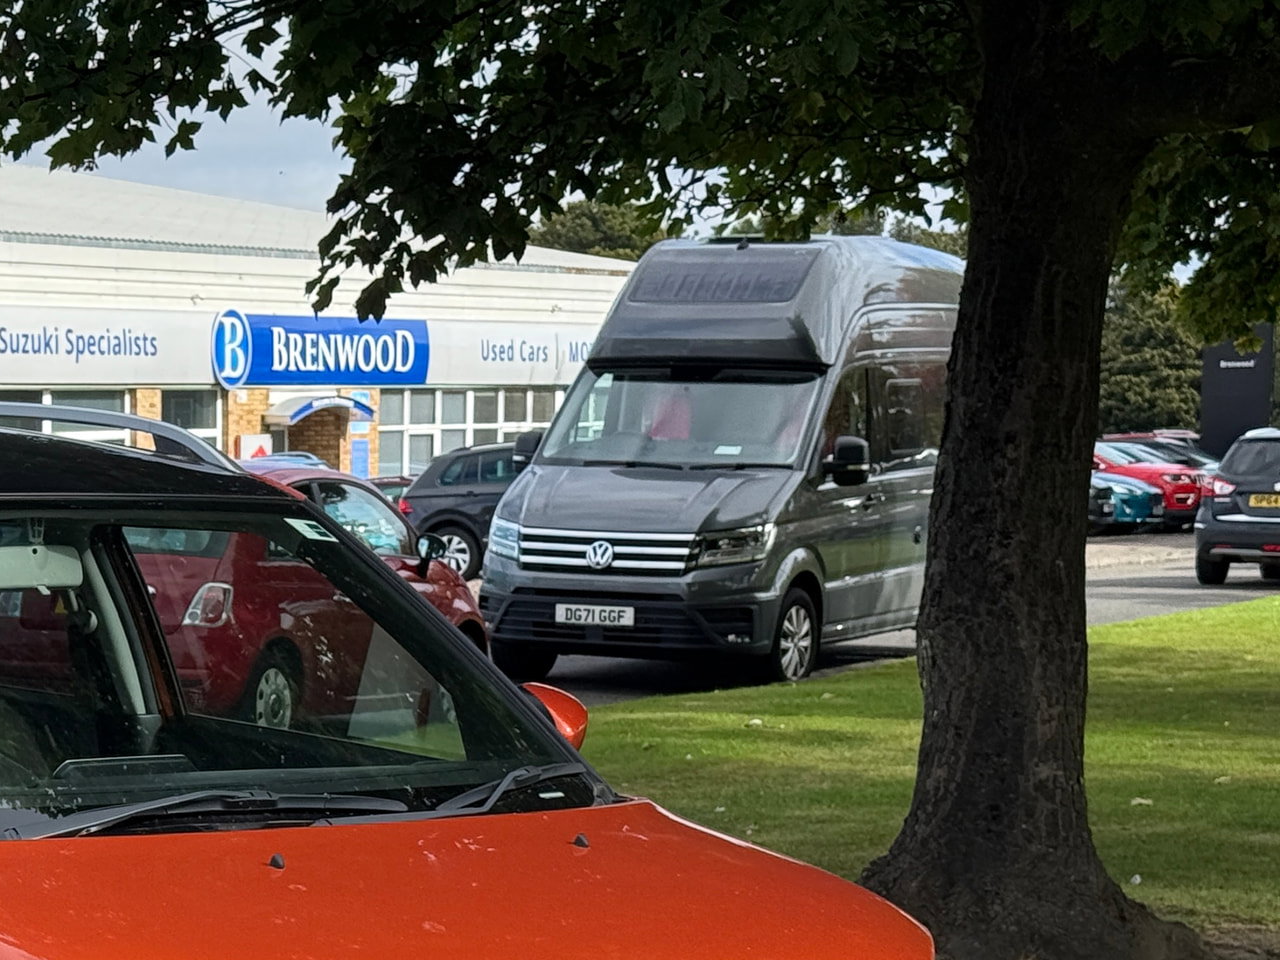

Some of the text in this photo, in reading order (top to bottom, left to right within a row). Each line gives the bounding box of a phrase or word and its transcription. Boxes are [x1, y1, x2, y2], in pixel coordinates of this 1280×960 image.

[64, 328, 158, 364] Specialists
[270, 326, 416, 373] BRENWOOD
[481, 339, 549, 363] Used Cars
[569, 341, 595, 363] MO
[565, 607, 627, 624] DG71 GGF
